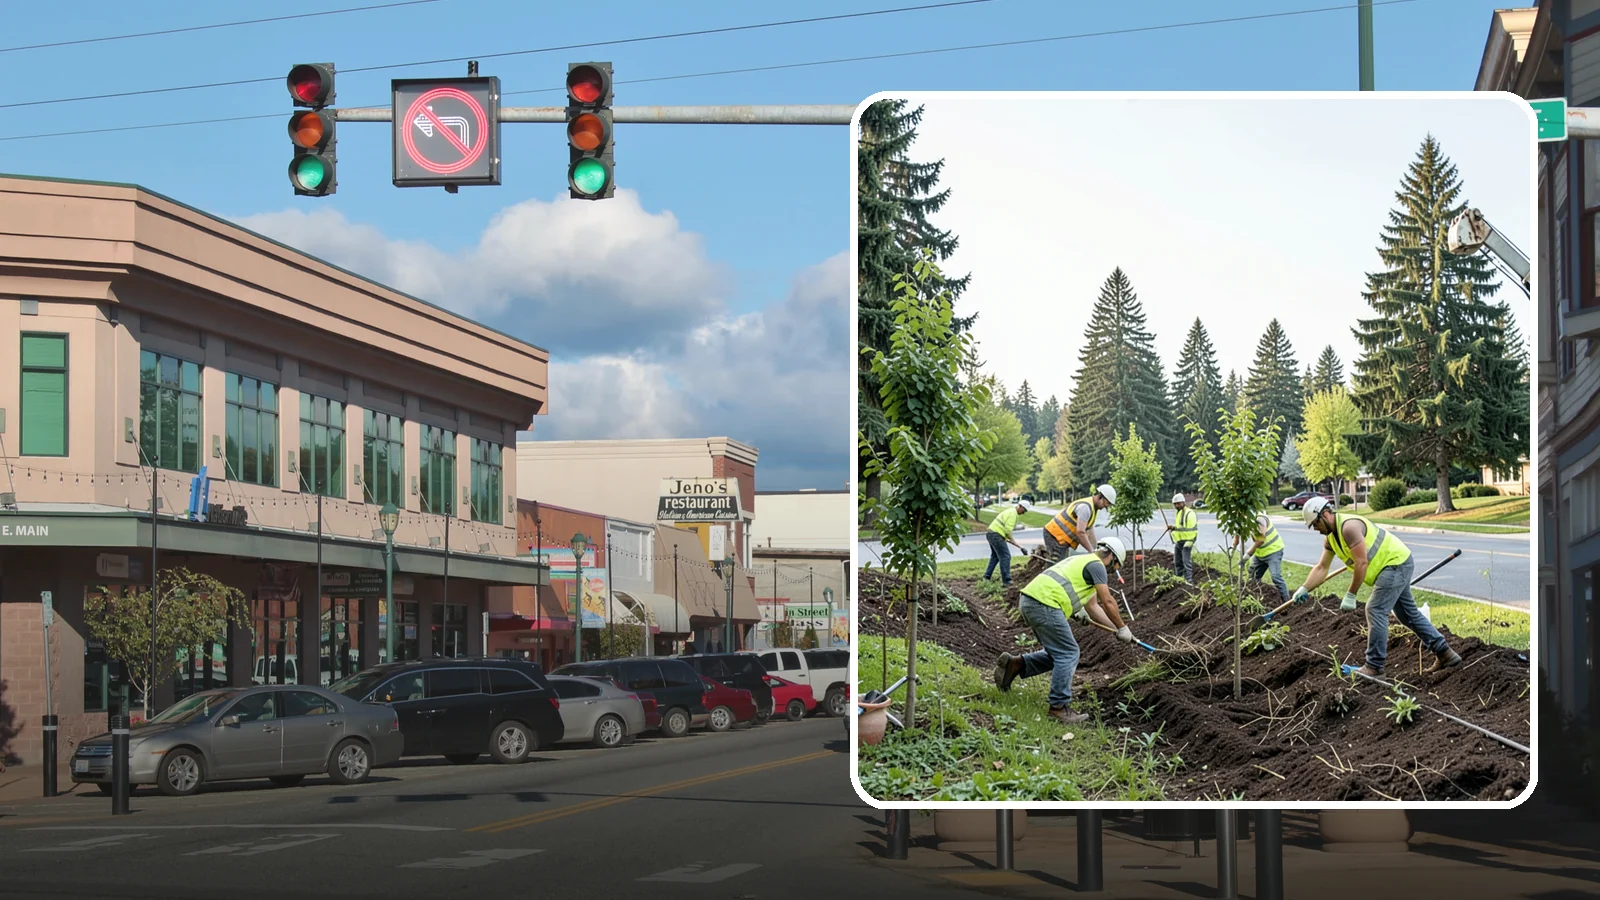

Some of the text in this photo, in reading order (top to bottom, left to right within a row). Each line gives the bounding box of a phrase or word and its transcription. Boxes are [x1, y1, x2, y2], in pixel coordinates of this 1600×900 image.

[669, 480, 728, 495] Jeno's
[665, 496, 731, 509] restaurant
[659, 510, 682, 520] Italian
[686, 510, 715, 519] American
[715, 510, 737, 519] Cuisine
[2, 525, 49, 536] E. MAIN
[786, 607, 795, 617] in
[797, 607, 828, 617] Street
[790, 619, 824, 627] lass
